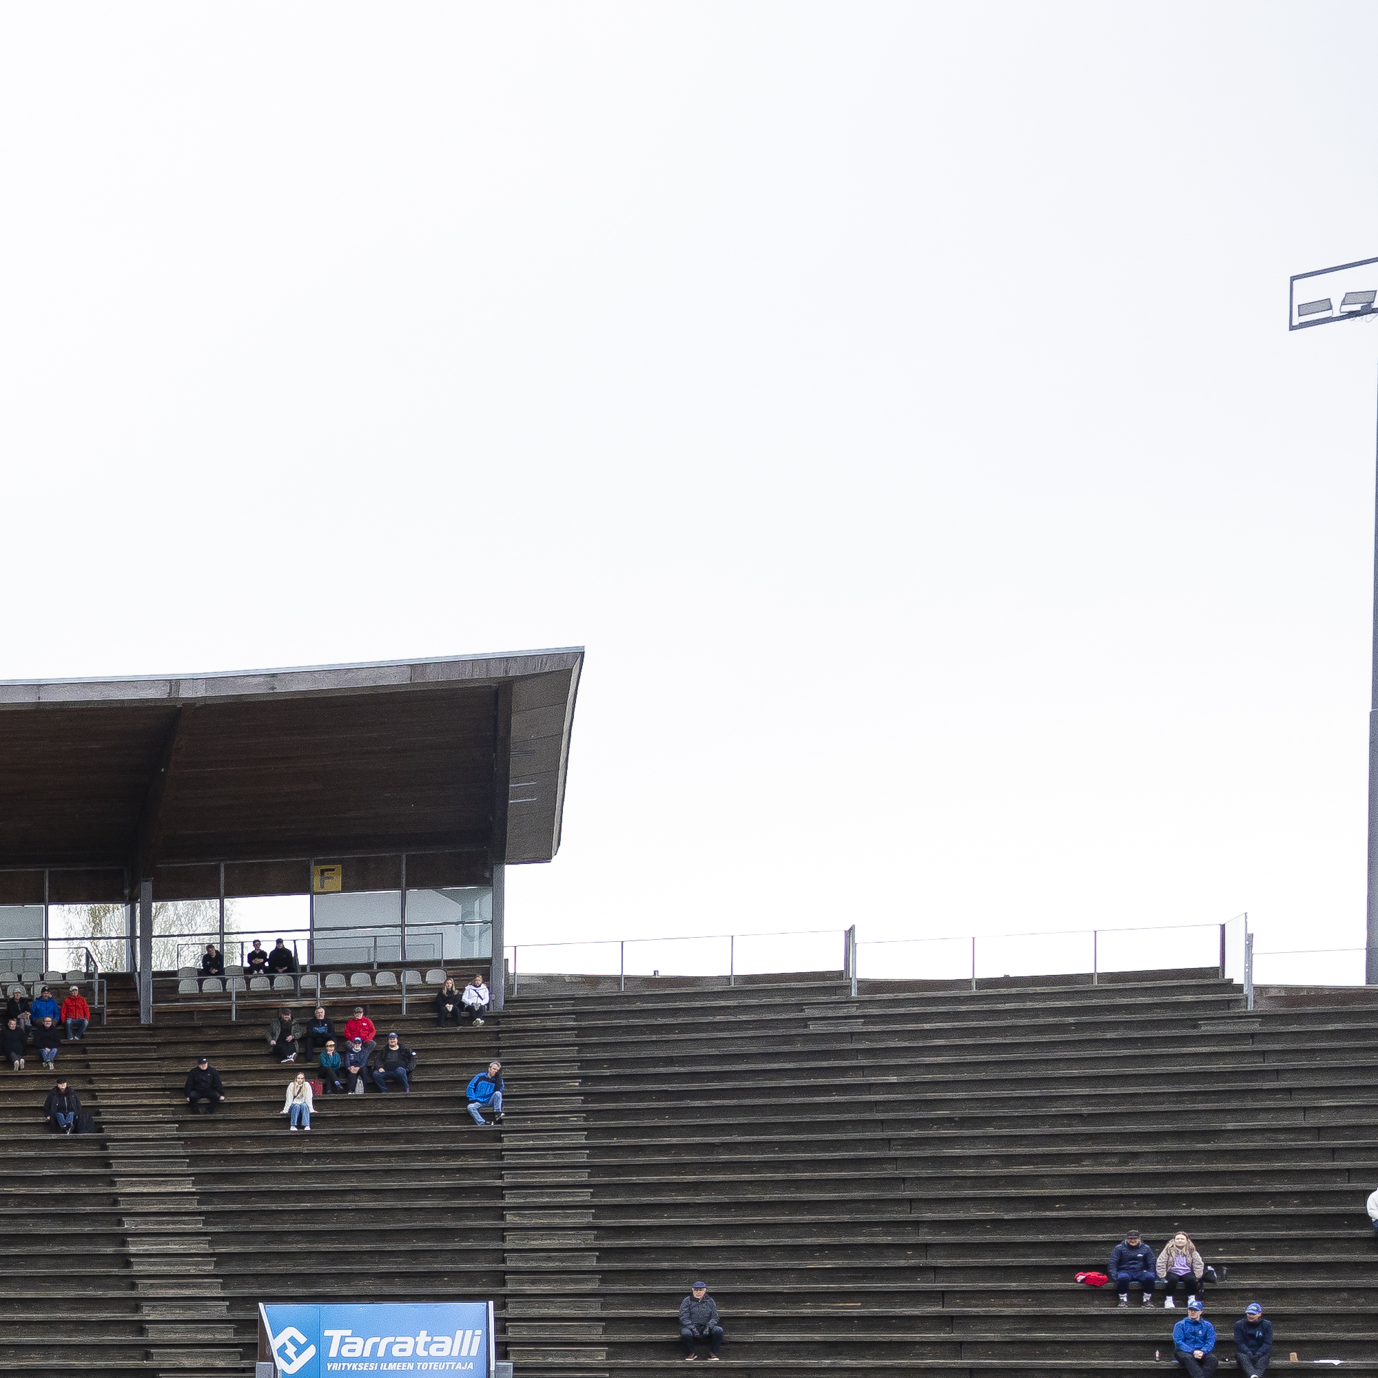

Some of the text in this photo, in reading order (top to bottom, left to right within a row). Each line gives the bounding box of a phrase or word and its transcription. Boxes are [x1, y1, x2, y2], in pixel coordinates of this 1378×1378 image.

[320, 868, 335, 889] F
[323, 1329, 483, 1358] Tarratalli
[326, 1362, 474, 1371] YRITYKSESI ILMEEN TOTEUTTAJA
